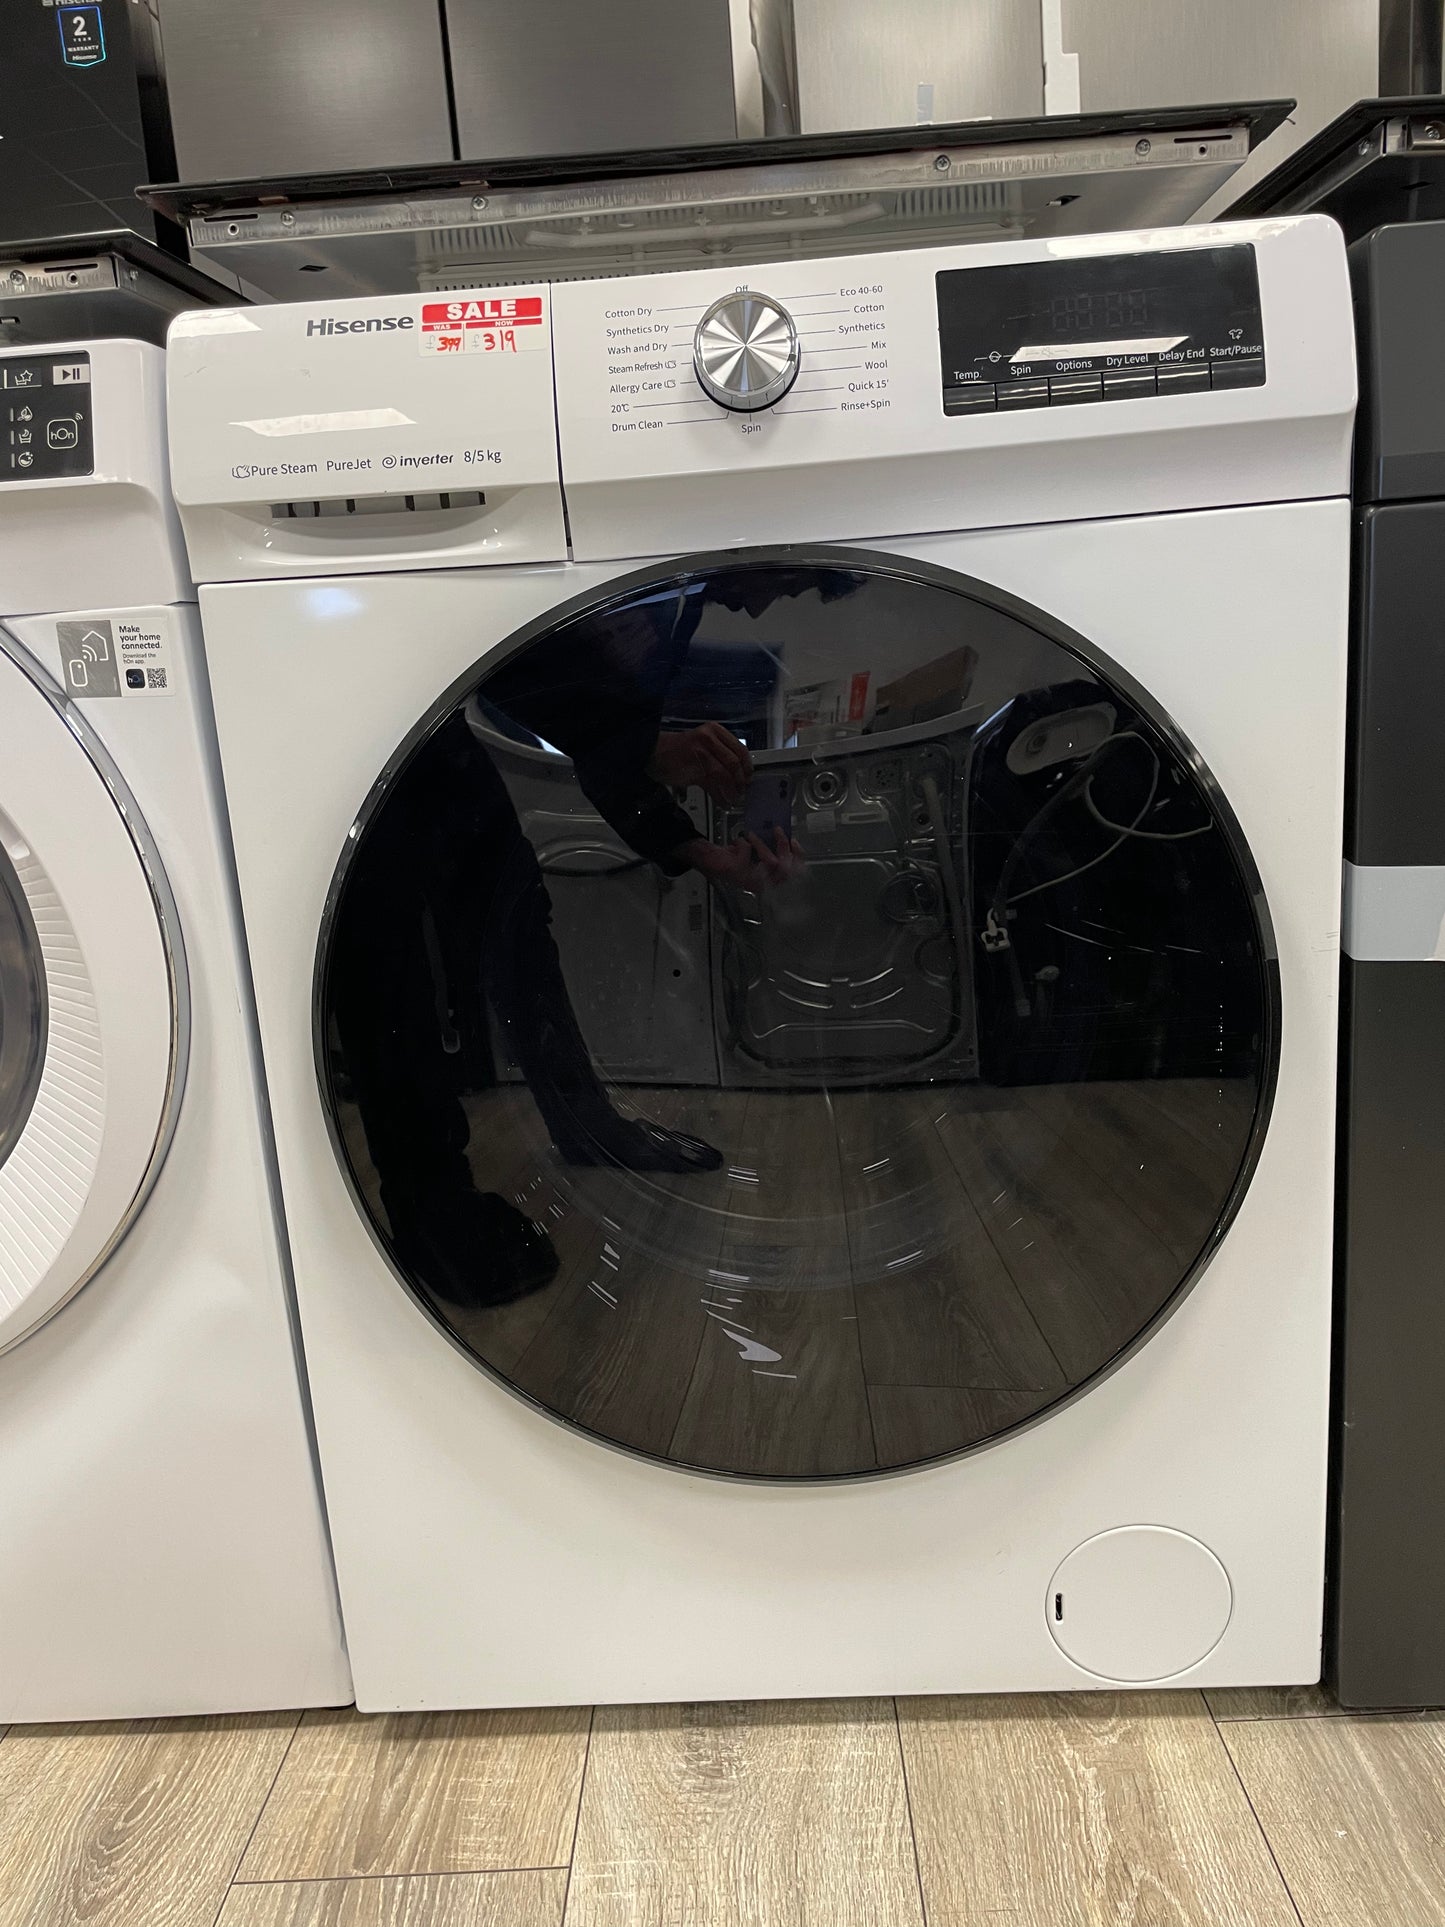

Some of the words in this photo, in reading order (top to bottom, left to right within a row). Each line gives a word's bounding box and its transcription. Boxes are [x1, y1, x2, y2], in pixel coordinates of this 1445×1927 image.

[72, 15, 87, 36] 2
[840, 287, 856, 297] Eco
[857, 285, 883, 295] 40-60
[446, 299, 517, 320] SALE
[605, 308, 636, 319] Cotton
[637, 307, 653, 318] Dry
[853, 303, 885, 313] Cotton
[306, 315, 414, 337] Hisense
[606, 324, 653, 337] Synthetics
[654, 323, 670, 334] Dry
[838, 321, 886, 334] Synthetics
[608, 344, 632, 355] Wash
[633, 343, 650, 353] and
[651, 342, 668, 353] Dry
[871, 341, 887, 350] Mix
[1210, 345, 1262, 357] Start/Pause
[1106, 355, 1122, 368] Dry
[1124, 353, 1149, 365] Level
[1158, 350, 1184, 363] Delay
[1186, 349, 1205, 360] End
[608, 364, 633, 375] Steam
[634, 361, 664, 372] Refresh
[865, 360, 889, 370] Wool
[1010, 365, 1032, 376] Spin
[1055, 359, 1092, 372] Options
[953, 369, 982, 382] Temp.
[610, 382, 640, 395] Allergy
[641, 380, 663, 391] Care
[848, 381, 874, 392] Quick
[875, 379, 890, 390] 15'
[841, 398, 891, 412] Rinse+Spin
[612, 423, 637, 432] Drum
[638, 420, 663, 430] Clean
[741, 422, 762, 434] Spin
[51, 428, 74, 440] hOn
[400, 454, 454, 468] inverter
[464, 449, 485, 464] 8/5
[487, 449, 502, 463] kg
[251, 464, 278, 477] Pure
[280, 462, 318, 475] Steam
[326, 459, 372, 472] PureJet
[119, 625, 140, 633] Make
[120, 634, 138, 643] your
[139, 633, 161, 641] home
[121, 642, 163, 650] connected.
